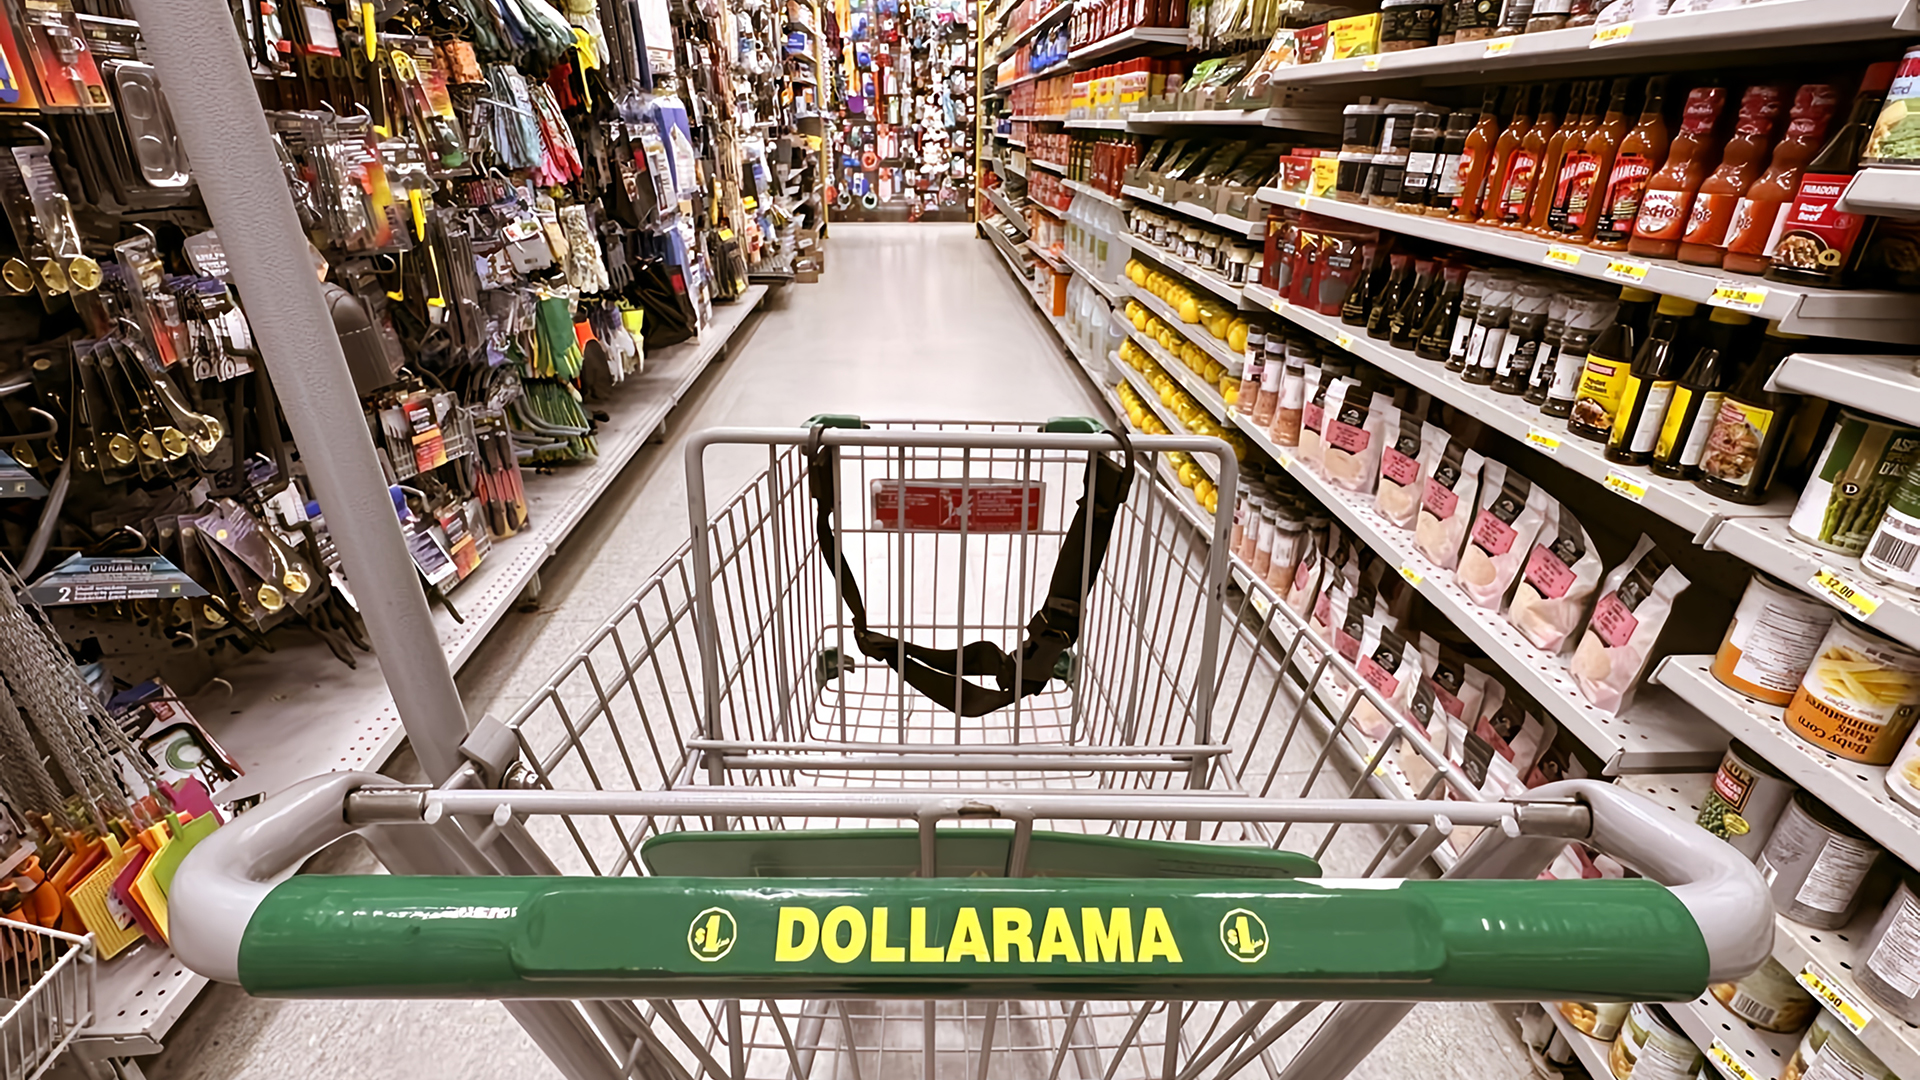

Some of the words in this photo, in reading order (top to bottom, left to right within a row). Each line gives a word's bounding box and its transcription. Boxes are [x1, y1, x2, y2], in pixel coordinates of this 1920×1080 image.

[58, 586, 71, 603] 2
[1826, 577, 1855, 599] $2.00
[1797, 715, 1827, 739] Corn
[1827, 733, 1869, 755] Baby
[774, 905, 1184, 964] DOLLARAMA
[1812, 979, 1843, 1008] $1.50
